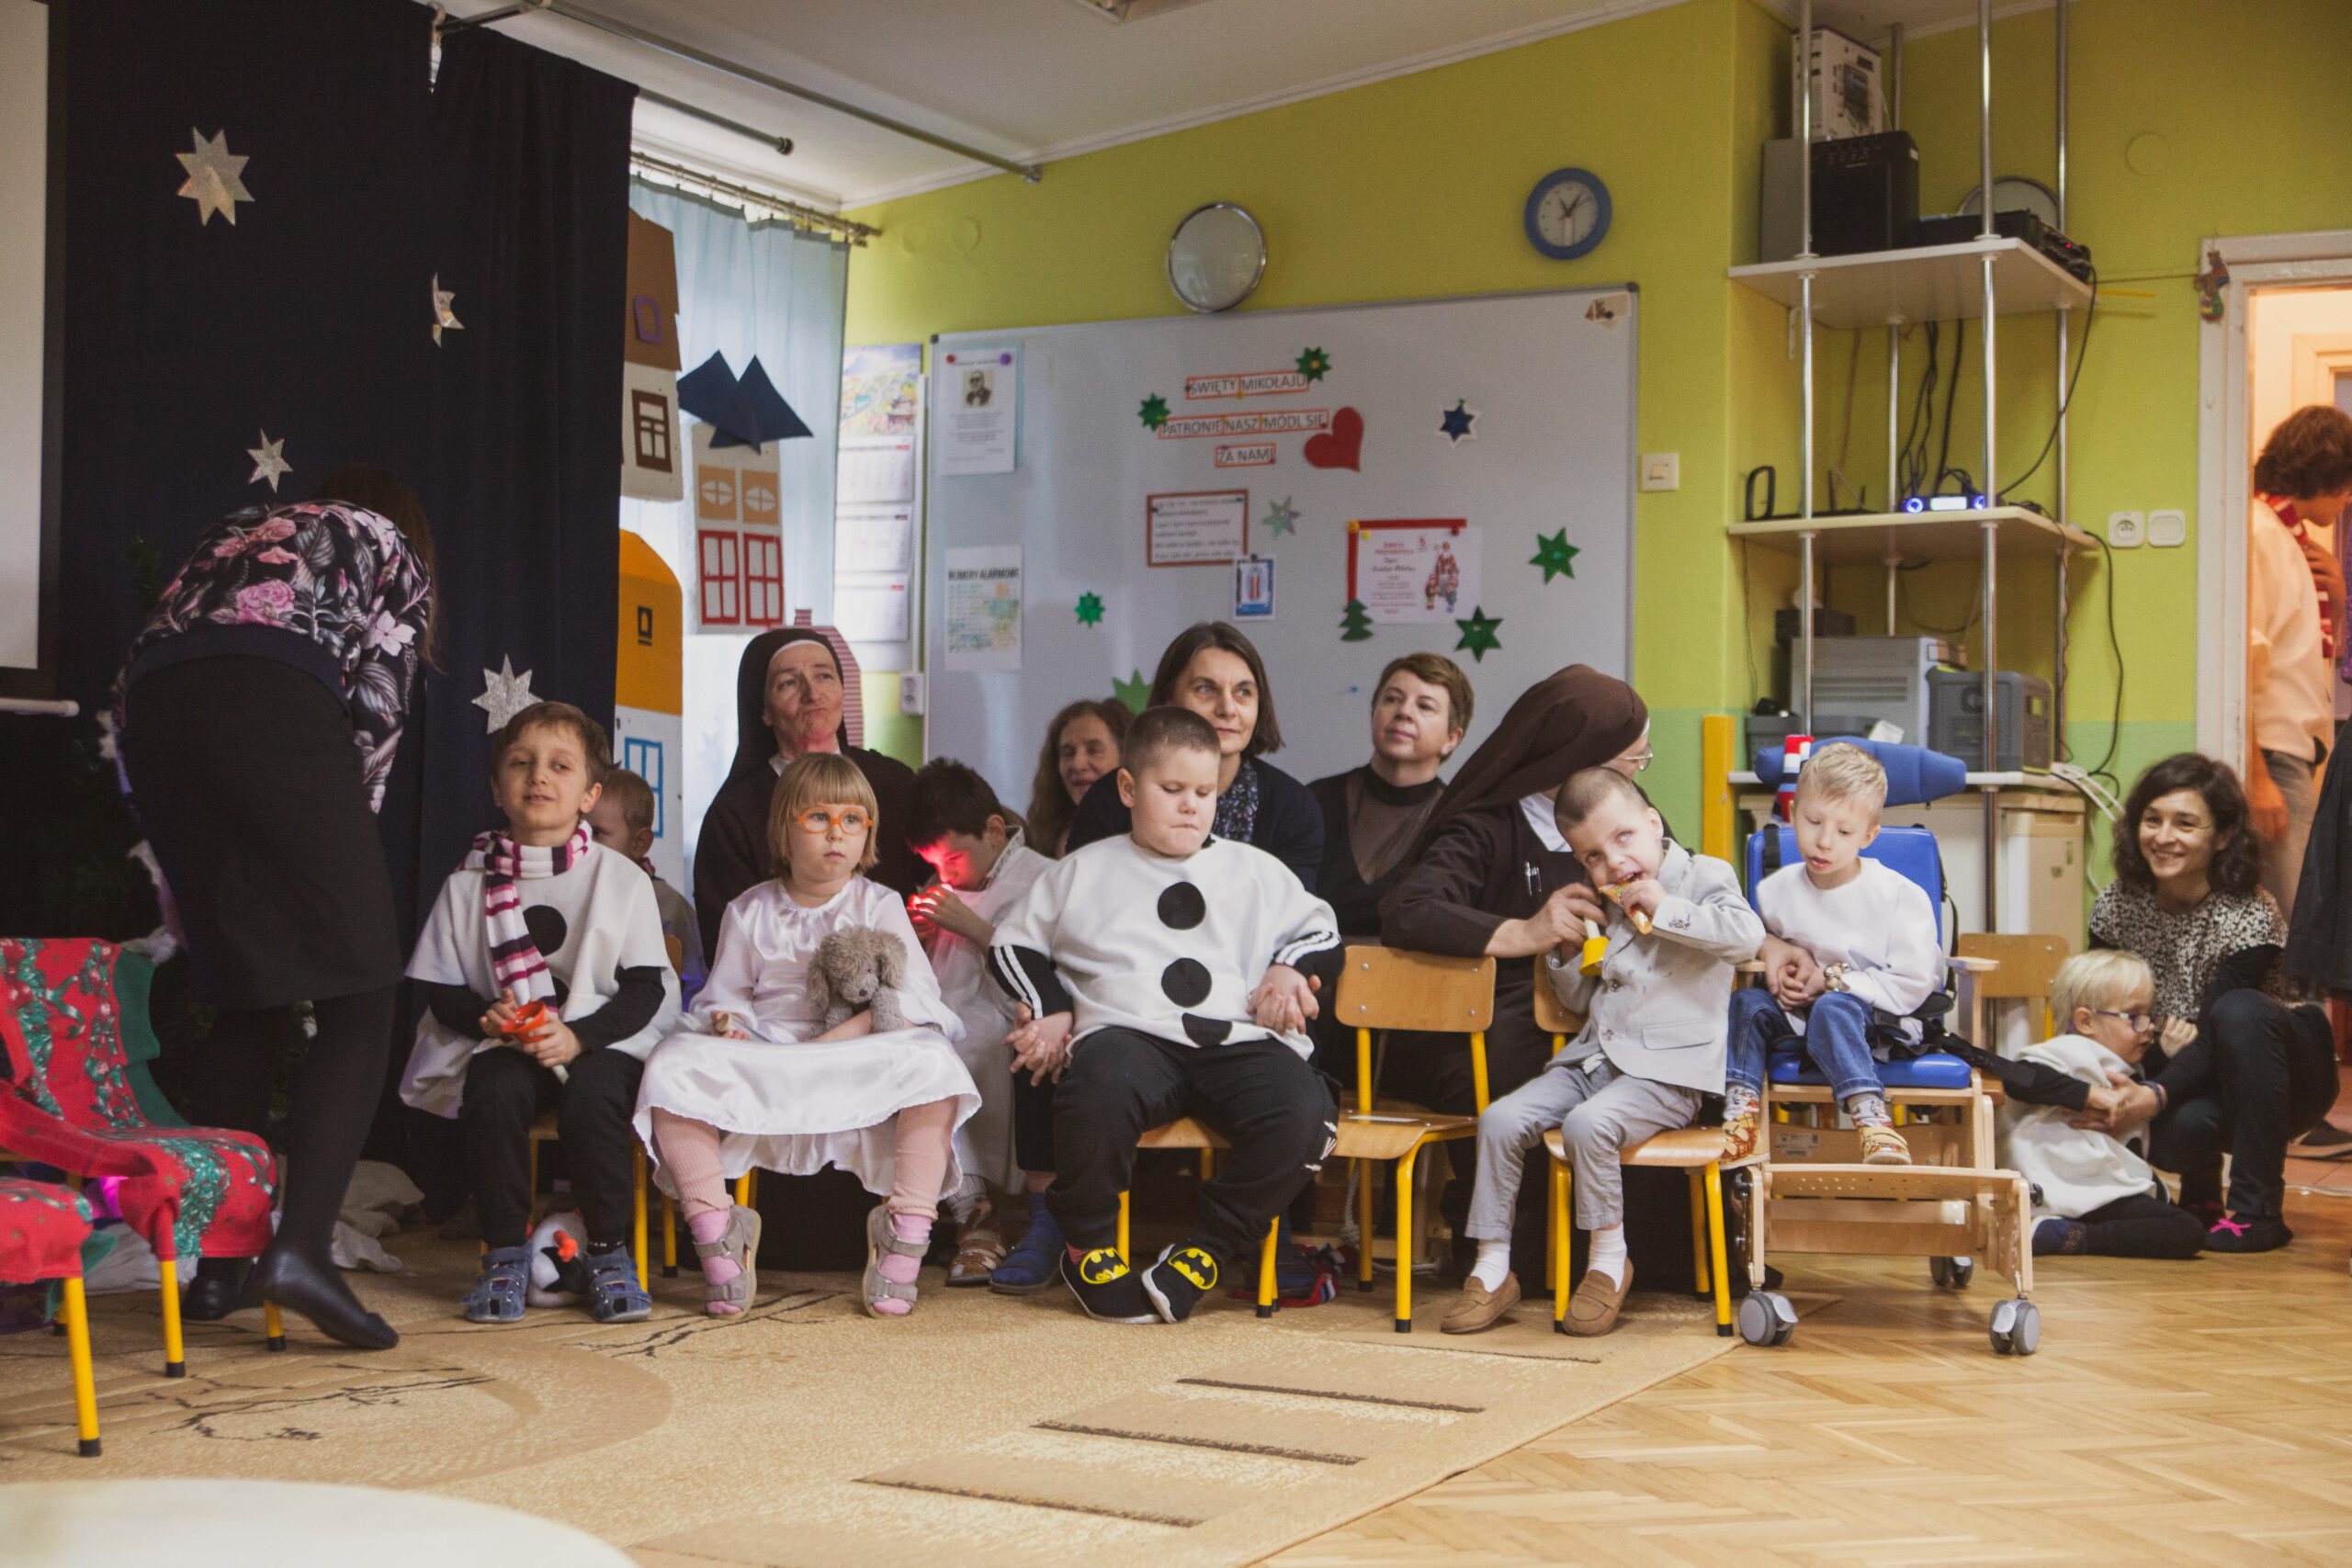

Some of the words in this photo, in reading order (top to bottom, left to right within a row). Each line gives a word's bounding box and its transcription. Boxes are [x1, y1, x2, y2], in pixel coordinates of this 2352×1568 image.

[1190, 378, 1237, 395] ŚWIĘTY
[1241, 375, 1306, 390] MIKOŁAJU
[1162, 420, 1222, 435] PATRONIE
[1226, 418, 1259, 432] NASZ
[1264, 414, 1304, 429] MÓDL
[1219, 450, 1234, 464] ZA
[1238, 447, 1273, 462] NAMI
